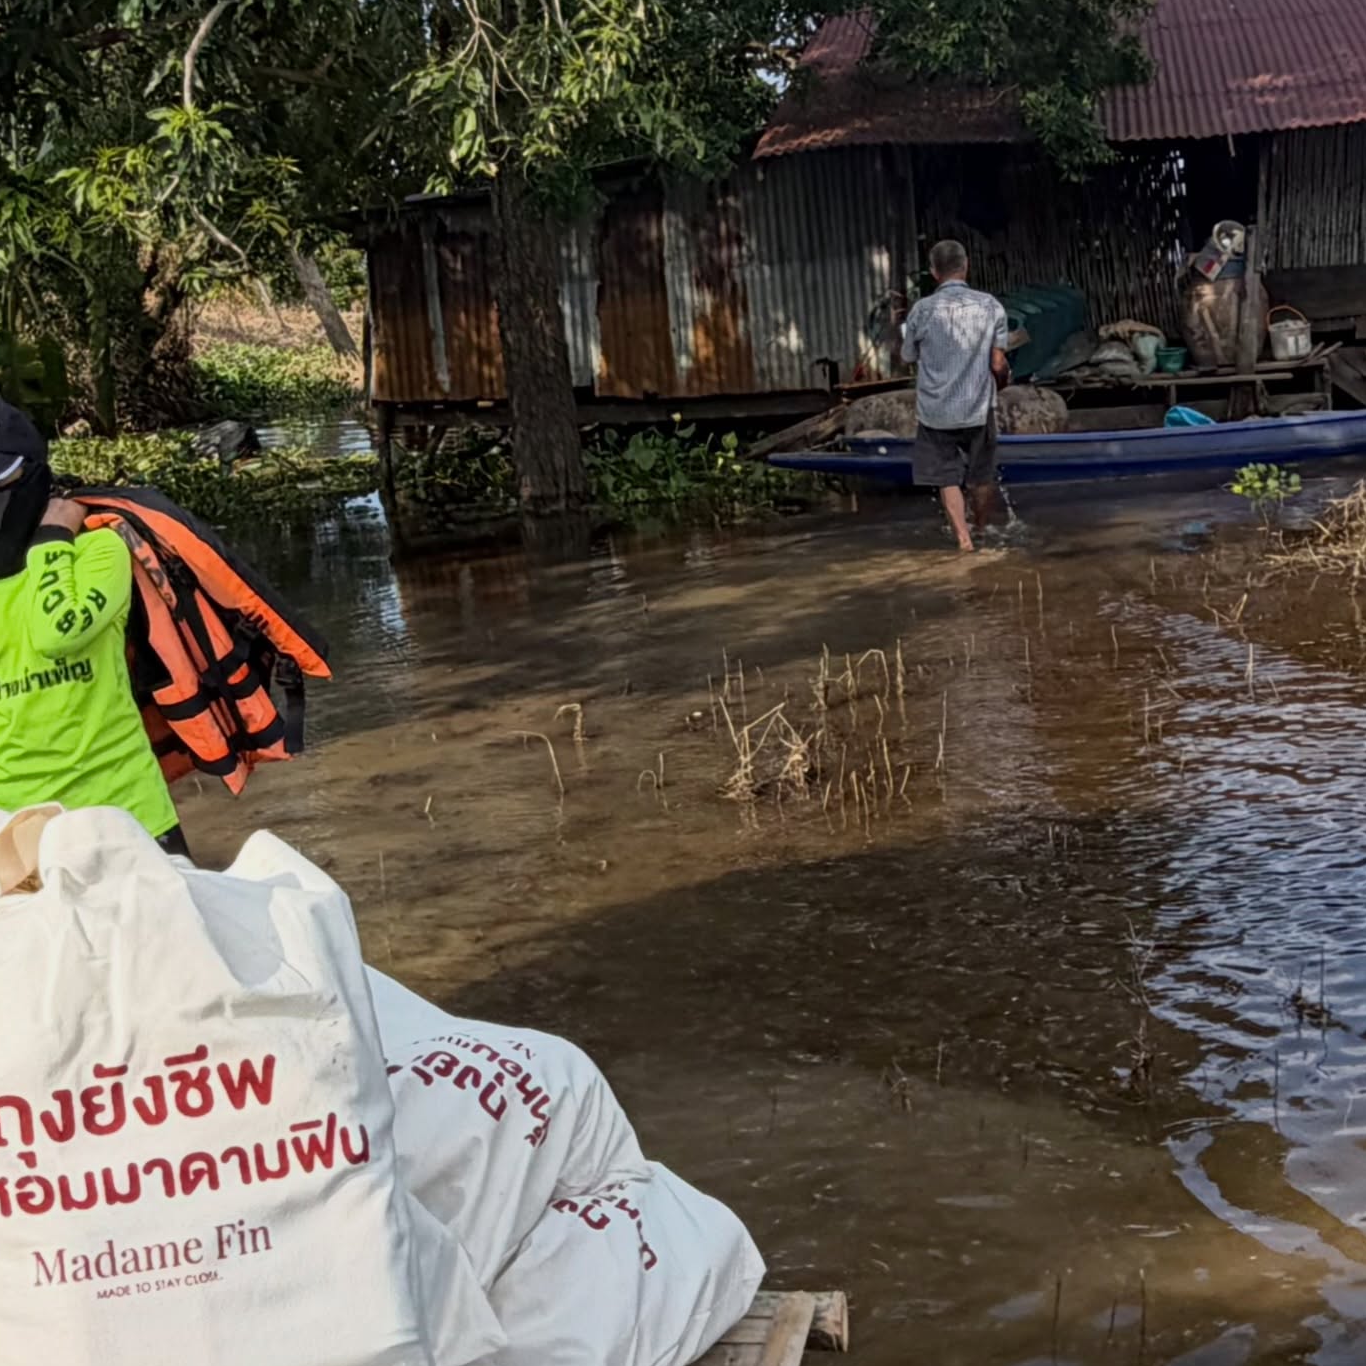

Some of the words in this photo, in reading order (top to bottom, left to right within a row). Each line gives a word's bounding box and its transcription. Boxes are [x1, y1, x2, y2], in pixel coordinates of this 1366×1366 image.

[31, 1236, 205, 1288] Madame
[213, 1219, 273, 1260] Fin
[96, 1284, 132, 1300] MADE
[136, 1282, 152, 1294] TO
[155, 1277, 182, 1292] STAY
